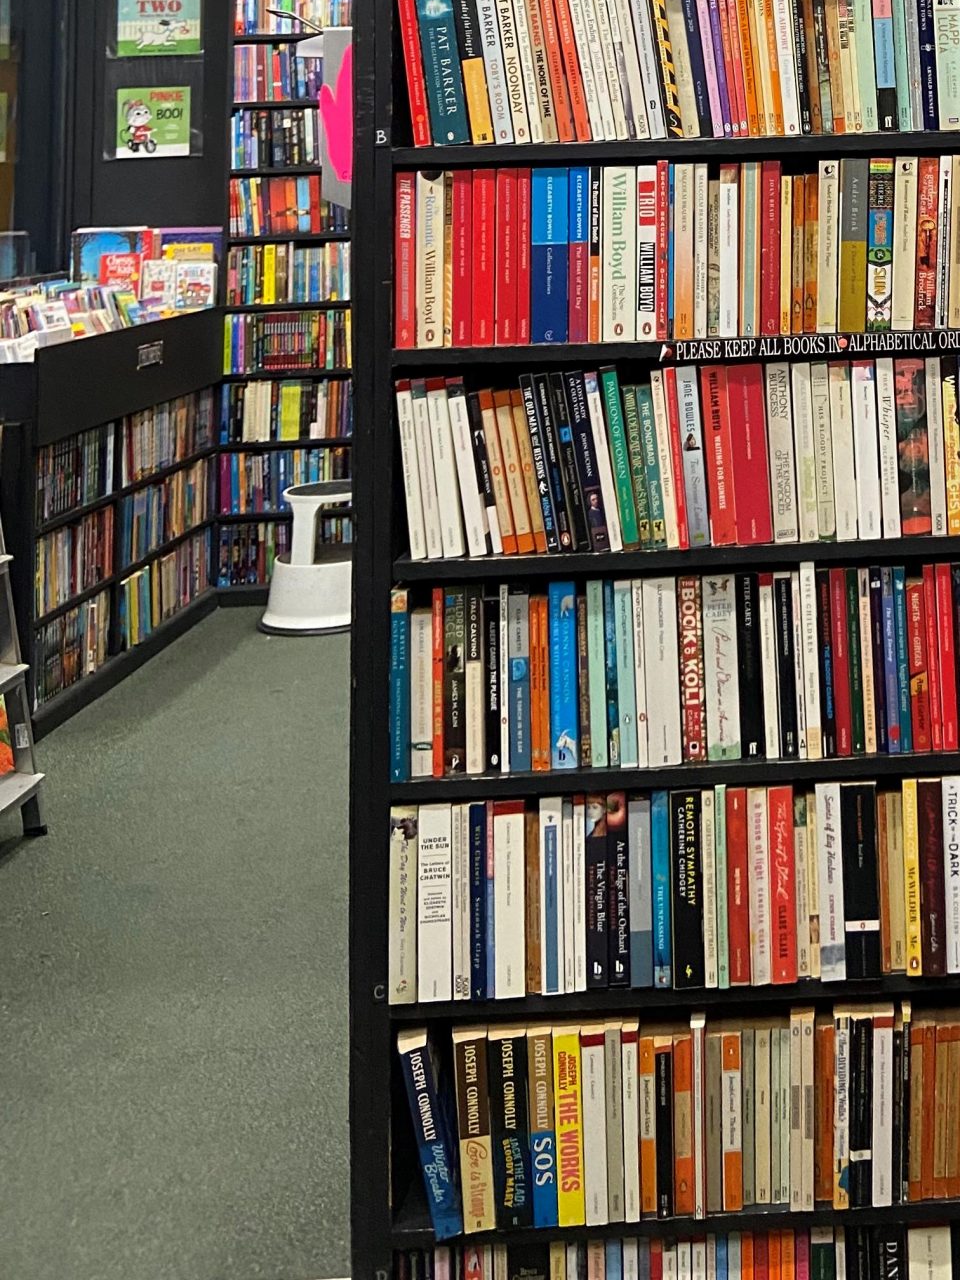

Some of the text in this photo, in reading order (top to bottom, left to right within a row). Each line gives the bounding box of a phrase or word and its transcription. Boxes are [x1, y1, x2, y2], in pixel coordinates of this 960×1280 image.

[136, 0, 183, 14] TWO
[436, 26, 456, 115] PAT BARKER
[499, 8, 514, 49] BARKER
[507, 56, 523, 114] NOONDAY
[149, 91, 184, 102] PINKIE
[156, 107, 183, 121] BOO!
[375, 129, 387, 144] B
[400, 179, 411, 238] THE PASSENGER
[608, 173, 627, 280] William Boyd
[639, 189, 654, 217] TRIO
[423, 195, 436, 324] Romantic William Boyd
[639, 242, 654, 312] WILLIAM BOYD
[676, 340, 721, 360] PLEASE
[724, 339, 756, 358] KEEP
[759, 337, 781, 356] ALL
[783, 336, 825, 355] BOOKS
[828, 336, 842, 353] IN
[849, 332, 937, 351] ALPHABETICAL
[768, 372, 780, 418] BURGESS
[777, 369, 788, 420] ANTHONY
[681, 588, 697, 645] BOOK
[685, 660, 699, 705] KOLI
[678, 807, 687, 897] CATHERINE CHIDGEY
[685, 797, 696, 905] REMOTE SYMPATHY
[595, 861, 605, 932] The Virgin Blue
[616, 840, 628, 953] At the Edge of the Orchard
[374, 984, 385, 999] C
[534, 1039, 550, 1129] JOSEPH CONNOLLY
[533, 1137, 553, 1186] SOS
[559, 1090, 580, 1193] THE WORKS
